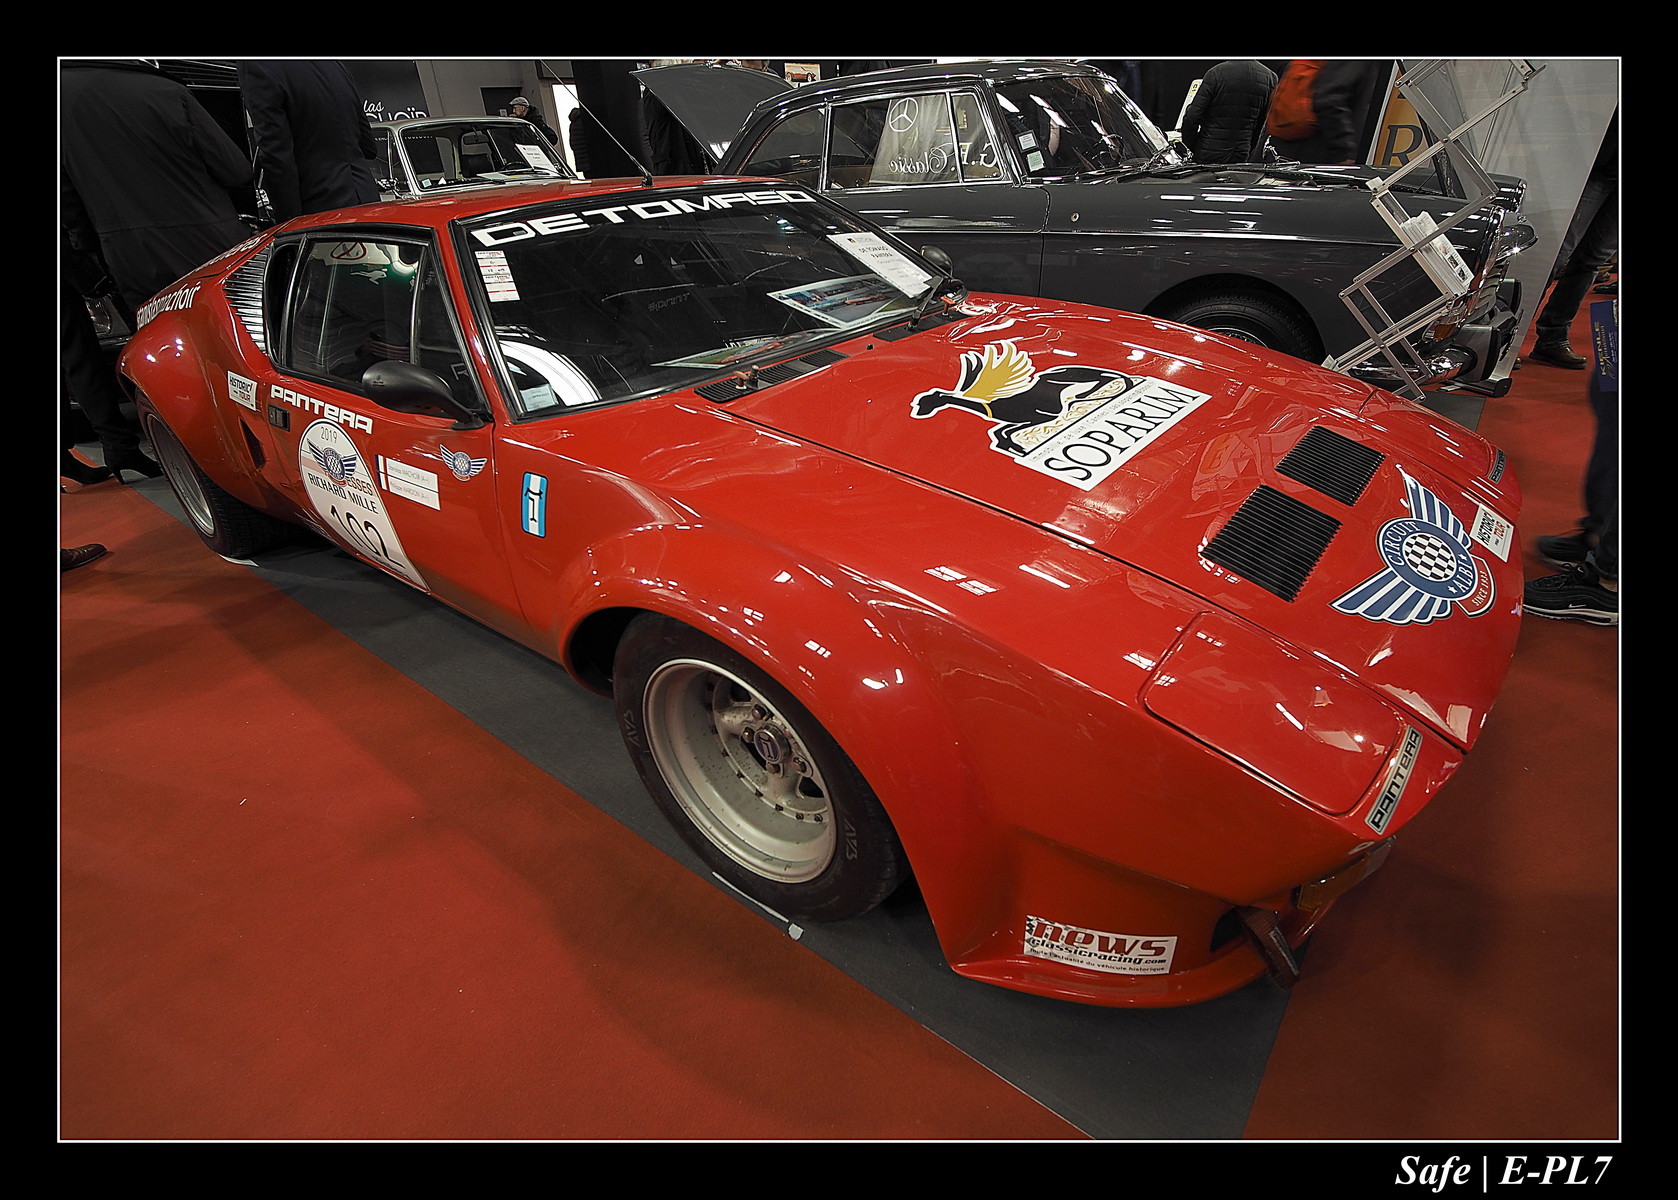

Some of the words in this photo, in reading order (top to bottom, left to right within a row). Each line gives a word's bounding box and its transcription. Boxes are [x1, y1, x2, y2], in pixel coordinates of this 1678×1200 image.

[229, 376, 252, 393] HISTORIC
[271, 384, 374, 434] PANTERA
[320, 426, 338, 444] 2019
[1044, 386, 1201, 482] SOPARIM
[307, 472, 346, 500] RICHARD
[347, 490, 379, 515] MILLE
[346, 478, 374, 497] ESSES
[330, 504, 406, 569] 102
[1384, 521, 1421, 566] CIRCUIT
[1477, 510, 1496, 546] HISTORIC
[1456, 560, 1474, 593] ALBI
[1471, 587, 1488, 607] SINCE
[1371, 729, 1420, 829] PANTERA
[1031, 937, 1167, 965] classicracing.com
[1032, 921, 1170, 957] news
[1128, 965, 1165, 974] historique
